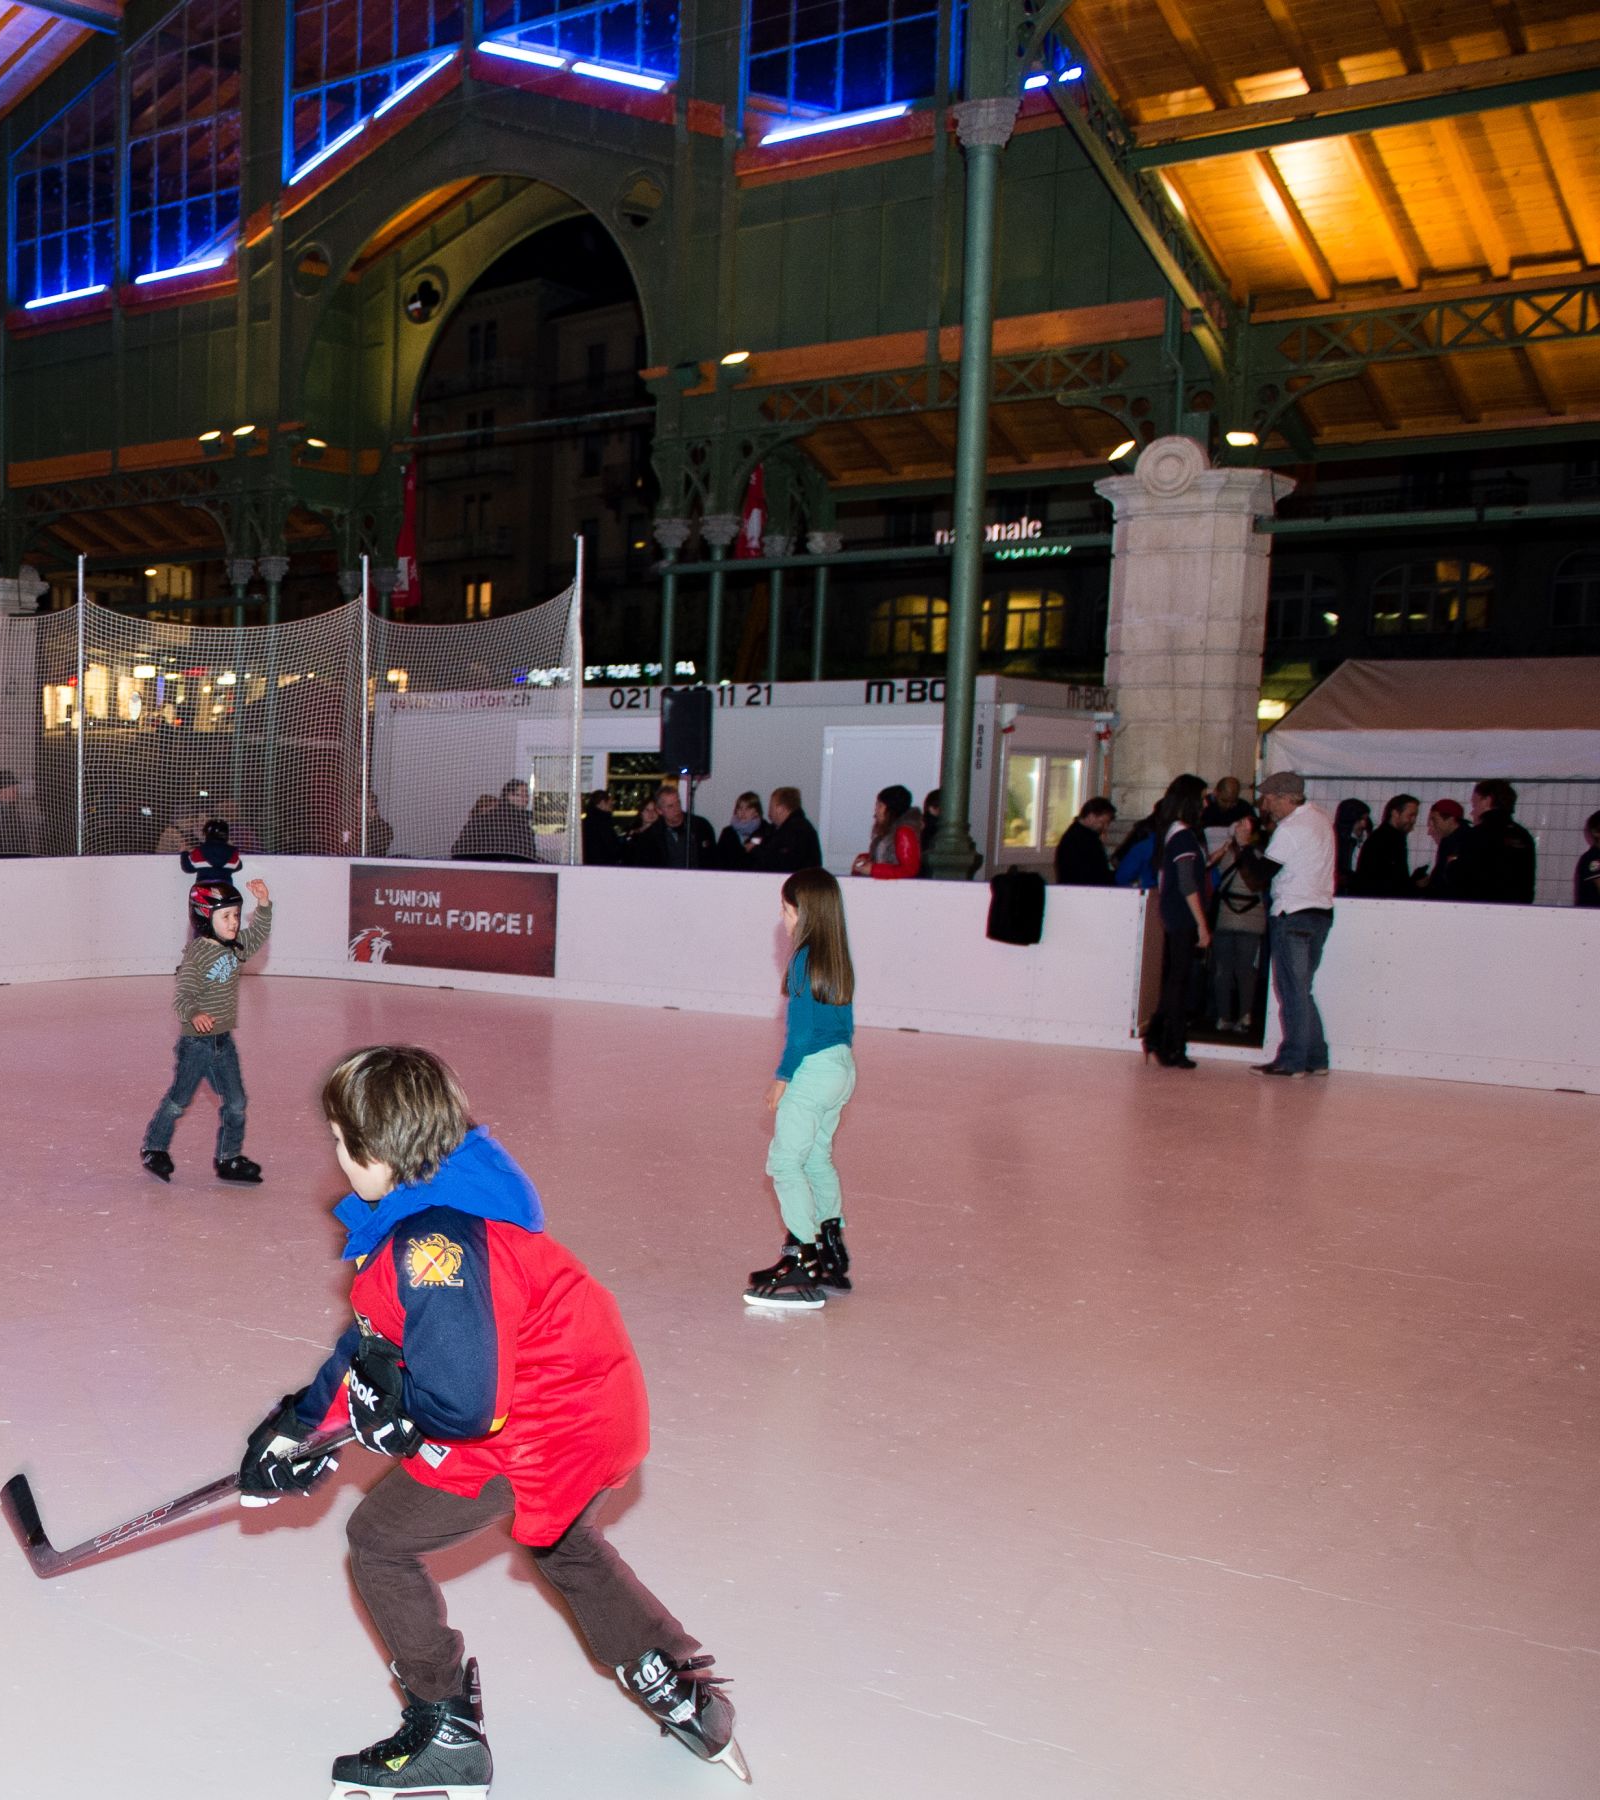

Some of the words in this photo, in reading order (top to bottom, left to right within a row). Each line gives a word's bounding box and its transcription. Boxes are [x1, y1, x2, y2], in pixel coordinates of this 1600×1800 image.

[609, 688, 650, 709] 021
[717, 685, 736, 707] 11
[745, 684, 773, 706] 21
[865, 679, 946, 704] M-BO
[374, 888, 441, 908] L'UNION
[395, 911, 423, 925] FAIT
[425, 913, 442, 926] LA
[446, 909, 522, 935] FORCE
[348, 1365, 380, 1412] bok
[632, 1654, 669, 1690] 101
